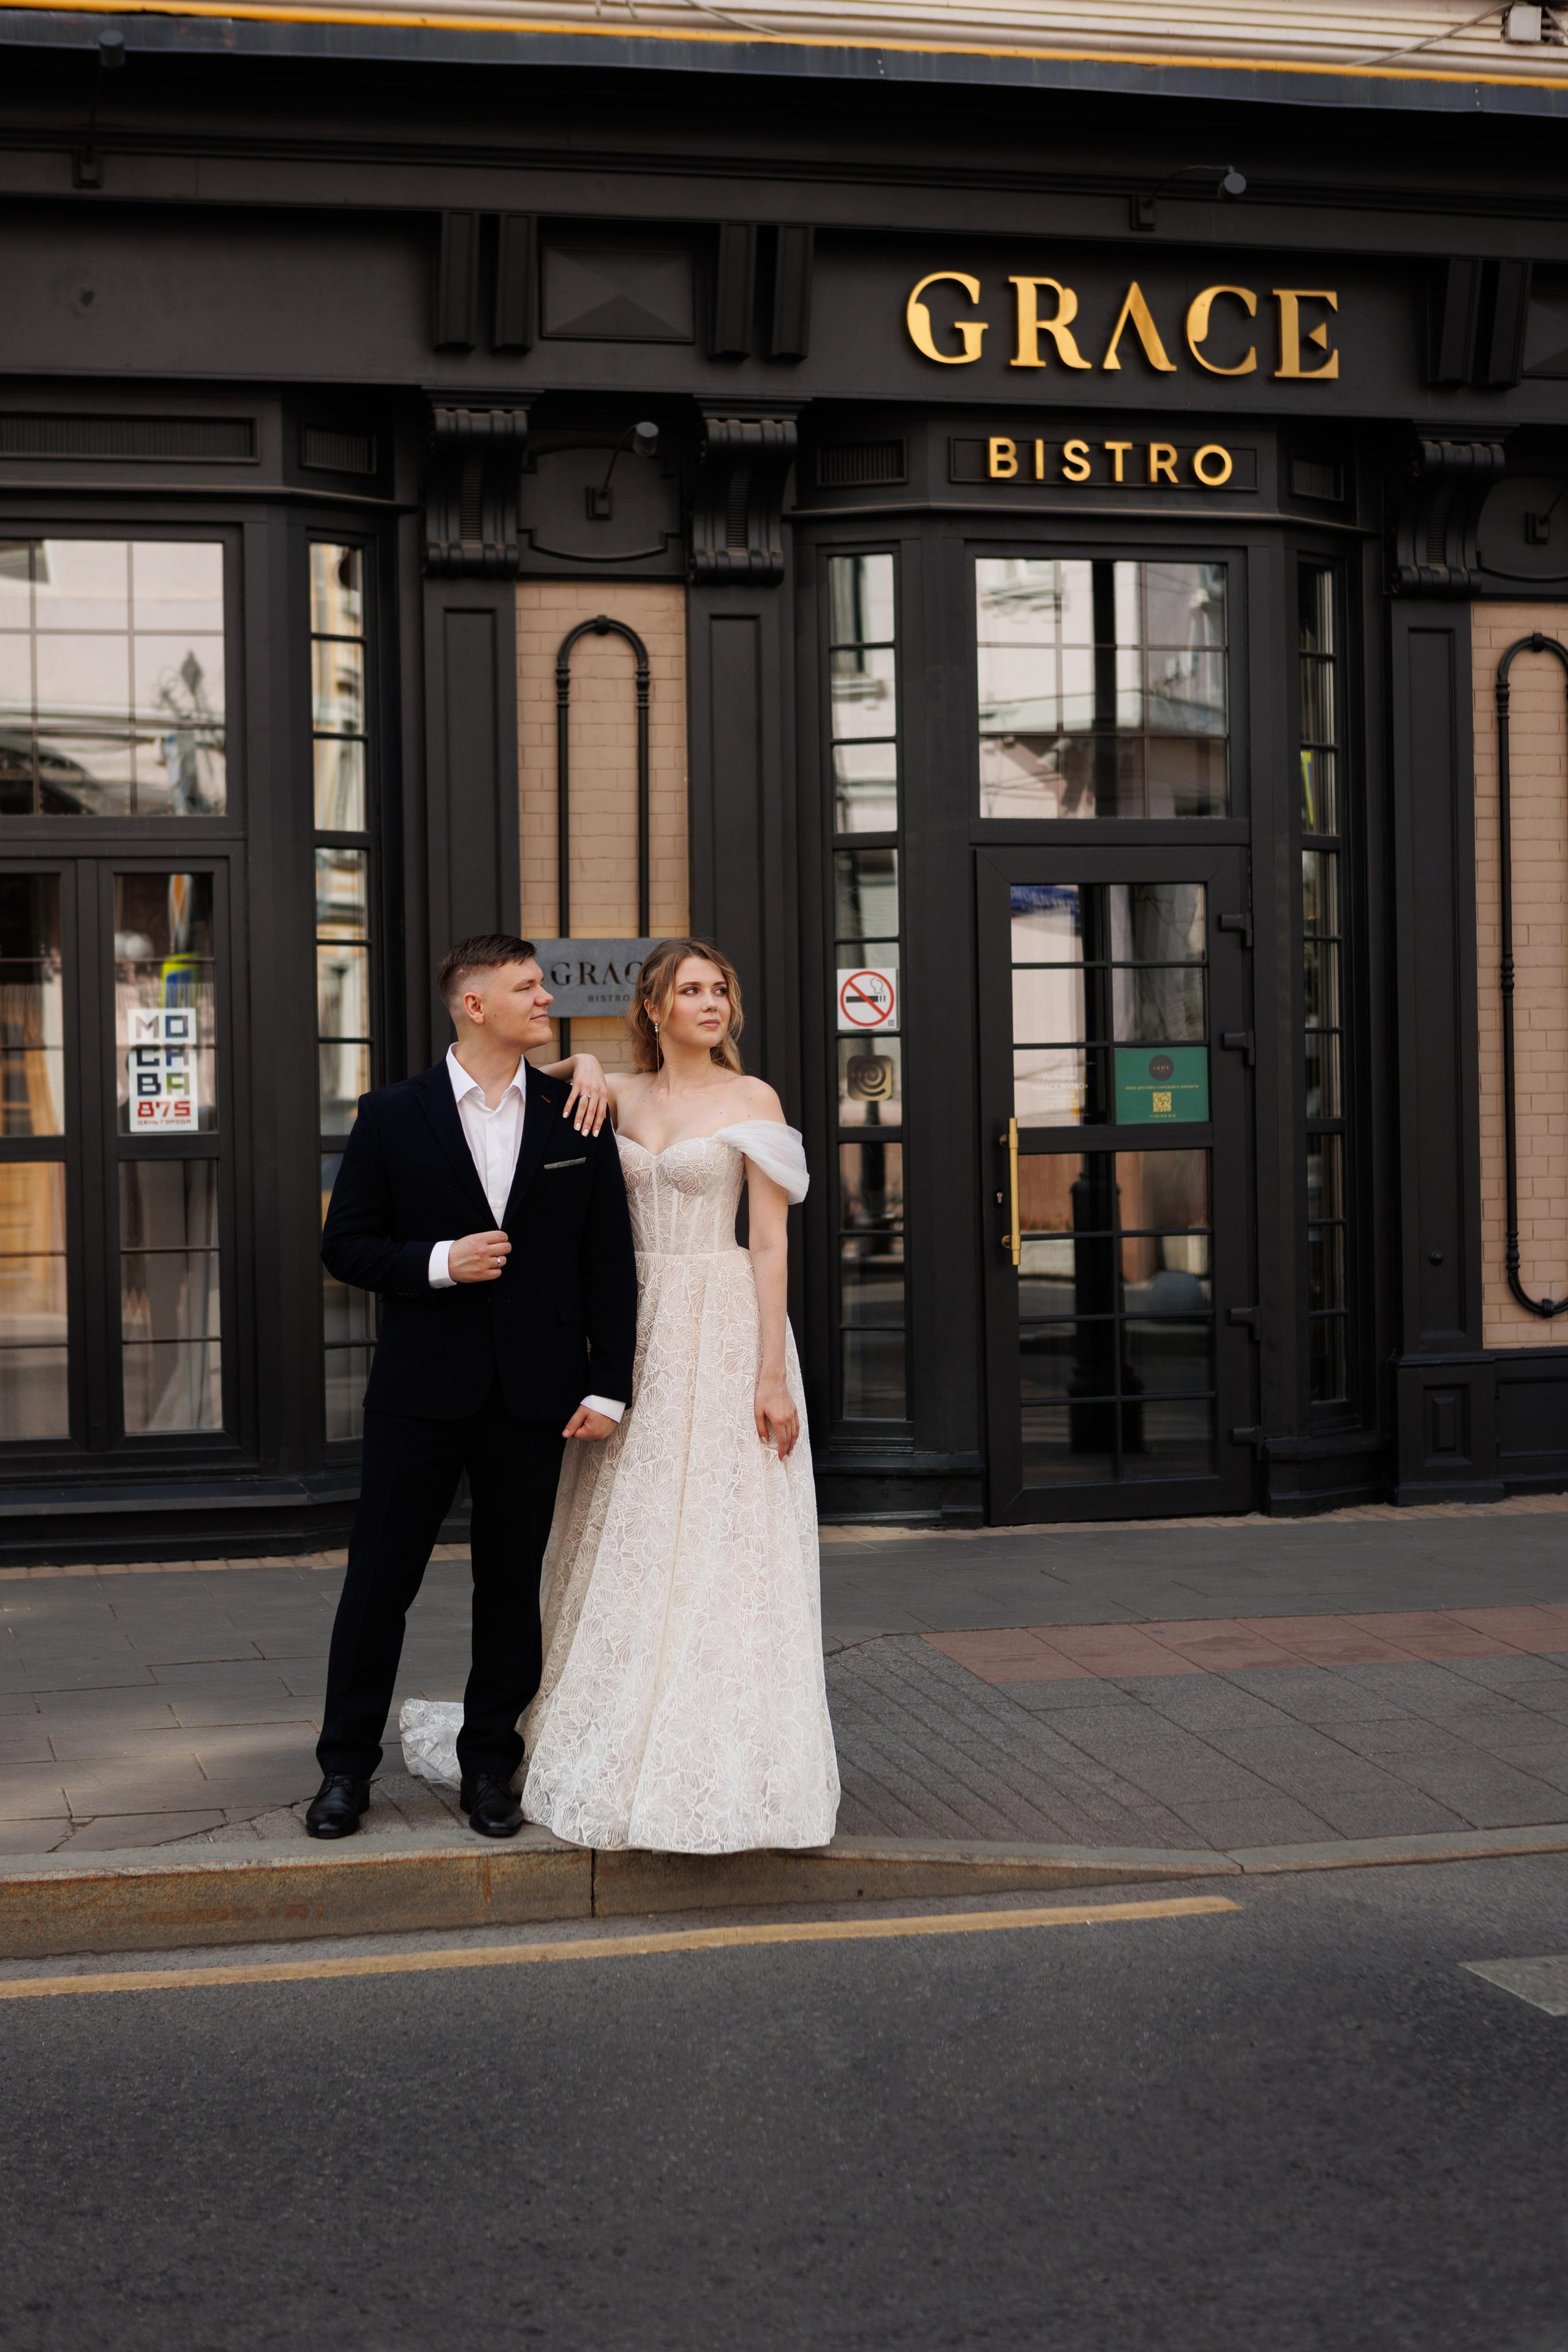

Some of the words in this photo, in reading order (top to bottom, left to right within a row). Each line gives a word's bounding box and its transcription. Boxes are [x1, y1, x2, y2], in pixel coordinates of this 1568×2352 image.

[906, 271, 1340, 379] GRACE
[988, 436, 1233, 486] BISTRO
[551, 960, 643, 986] GRAC
[138, 1101, 190, 1117] 875
